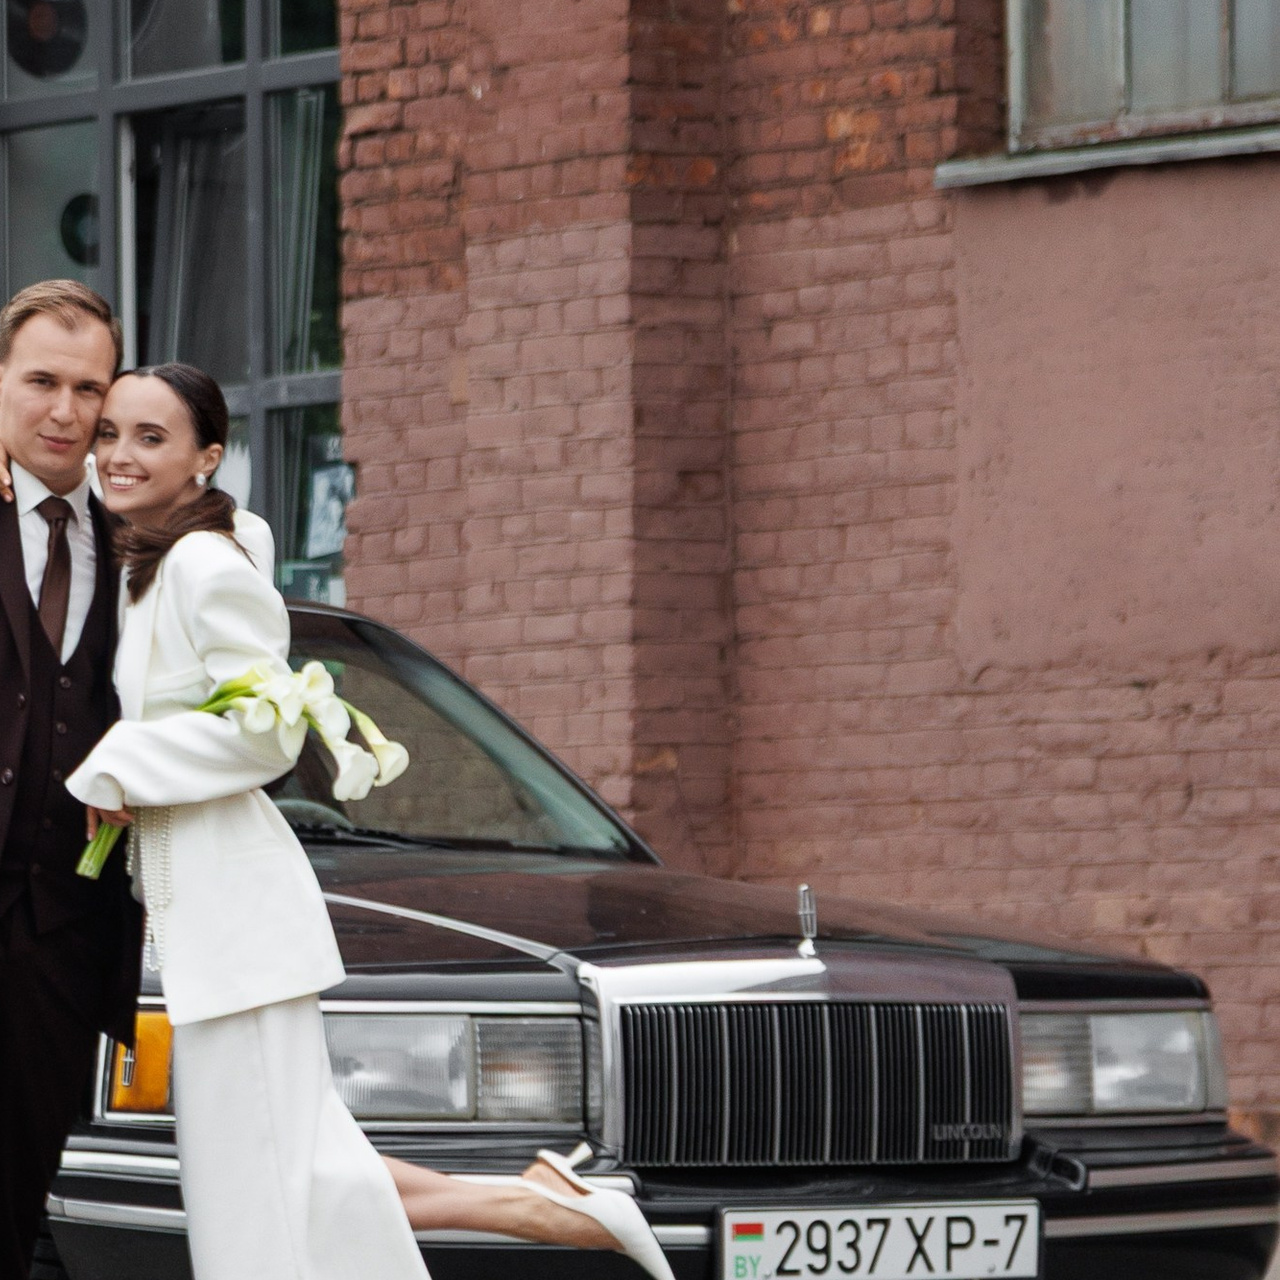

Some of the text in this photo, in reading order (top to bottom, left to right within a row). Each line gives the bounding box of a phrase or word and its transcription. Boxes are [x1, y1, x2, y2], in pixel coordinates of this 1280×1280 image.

[933, 1123, 1002, 1141] LINCOLN
[775, 1218, 892, 1277] 2937
[734, 1255, 761, 1279] BY
